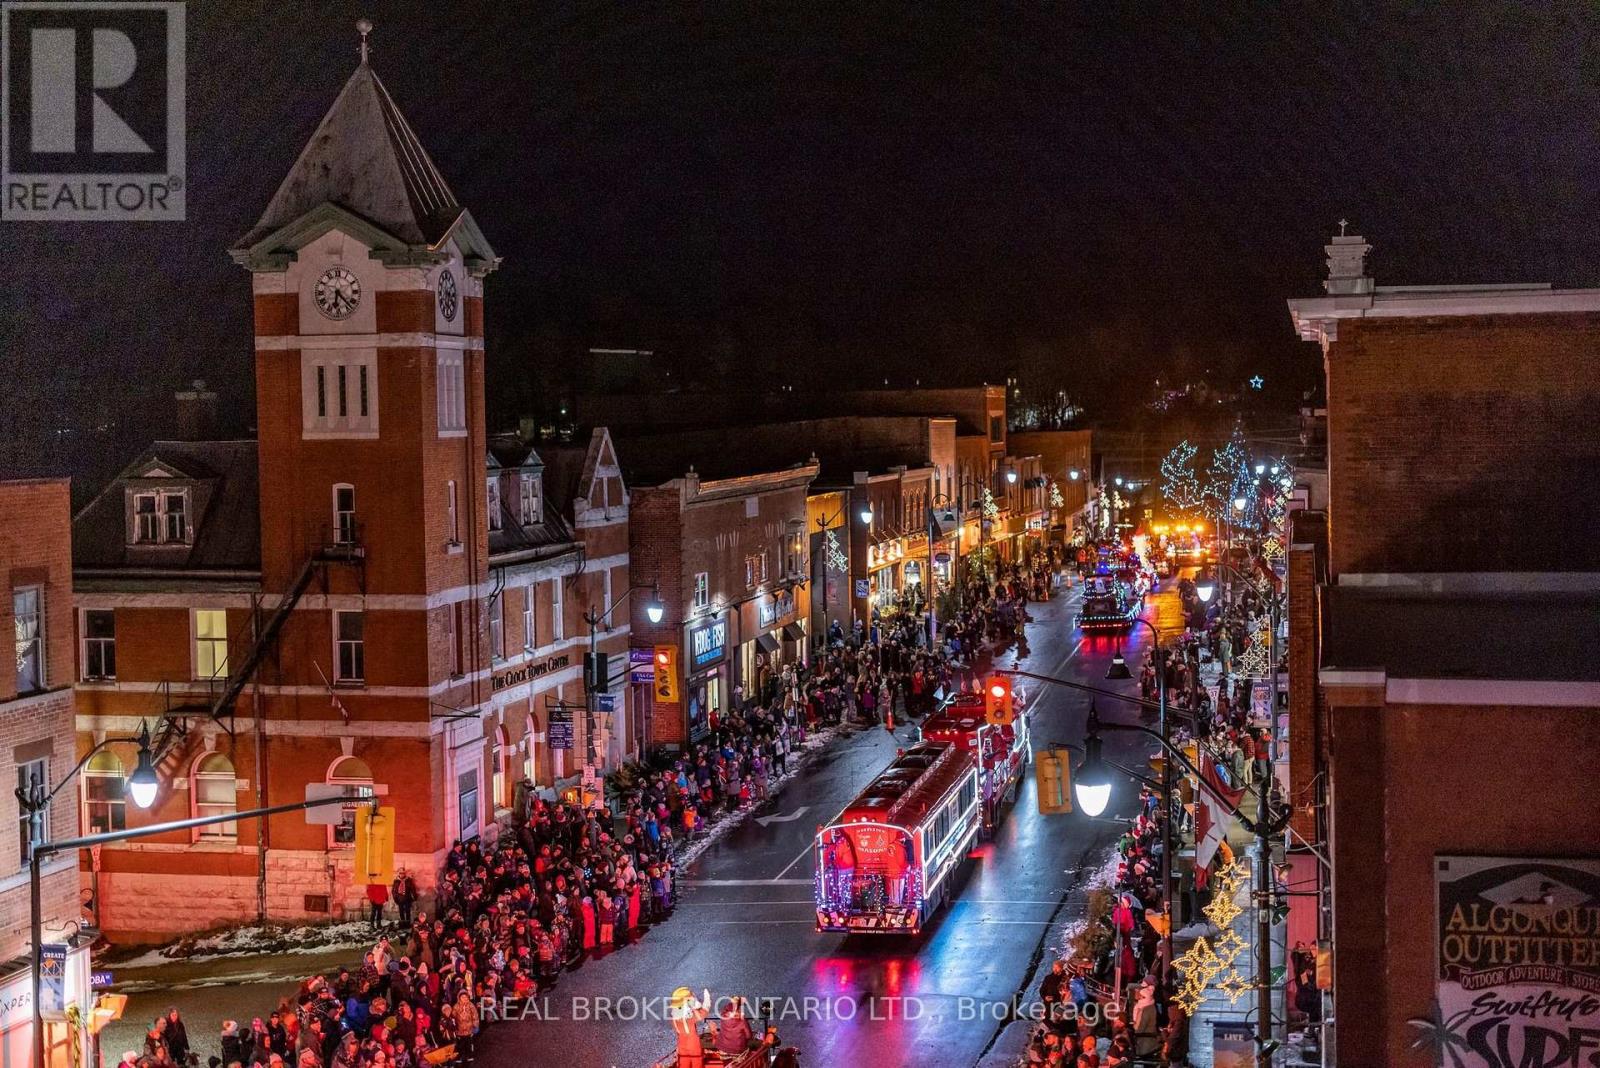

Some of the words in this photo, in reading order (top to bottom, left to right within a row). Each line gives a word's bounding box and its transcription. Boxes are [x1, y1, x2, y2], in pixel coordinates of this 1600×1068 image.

[505, 669, 527, 687] CLOCK
[527, 663, 548, 679] TOWER
[1462, 971, 1505, 989] OUTDOOR
[1508, 966, 1562, 981] ADVENTURE
